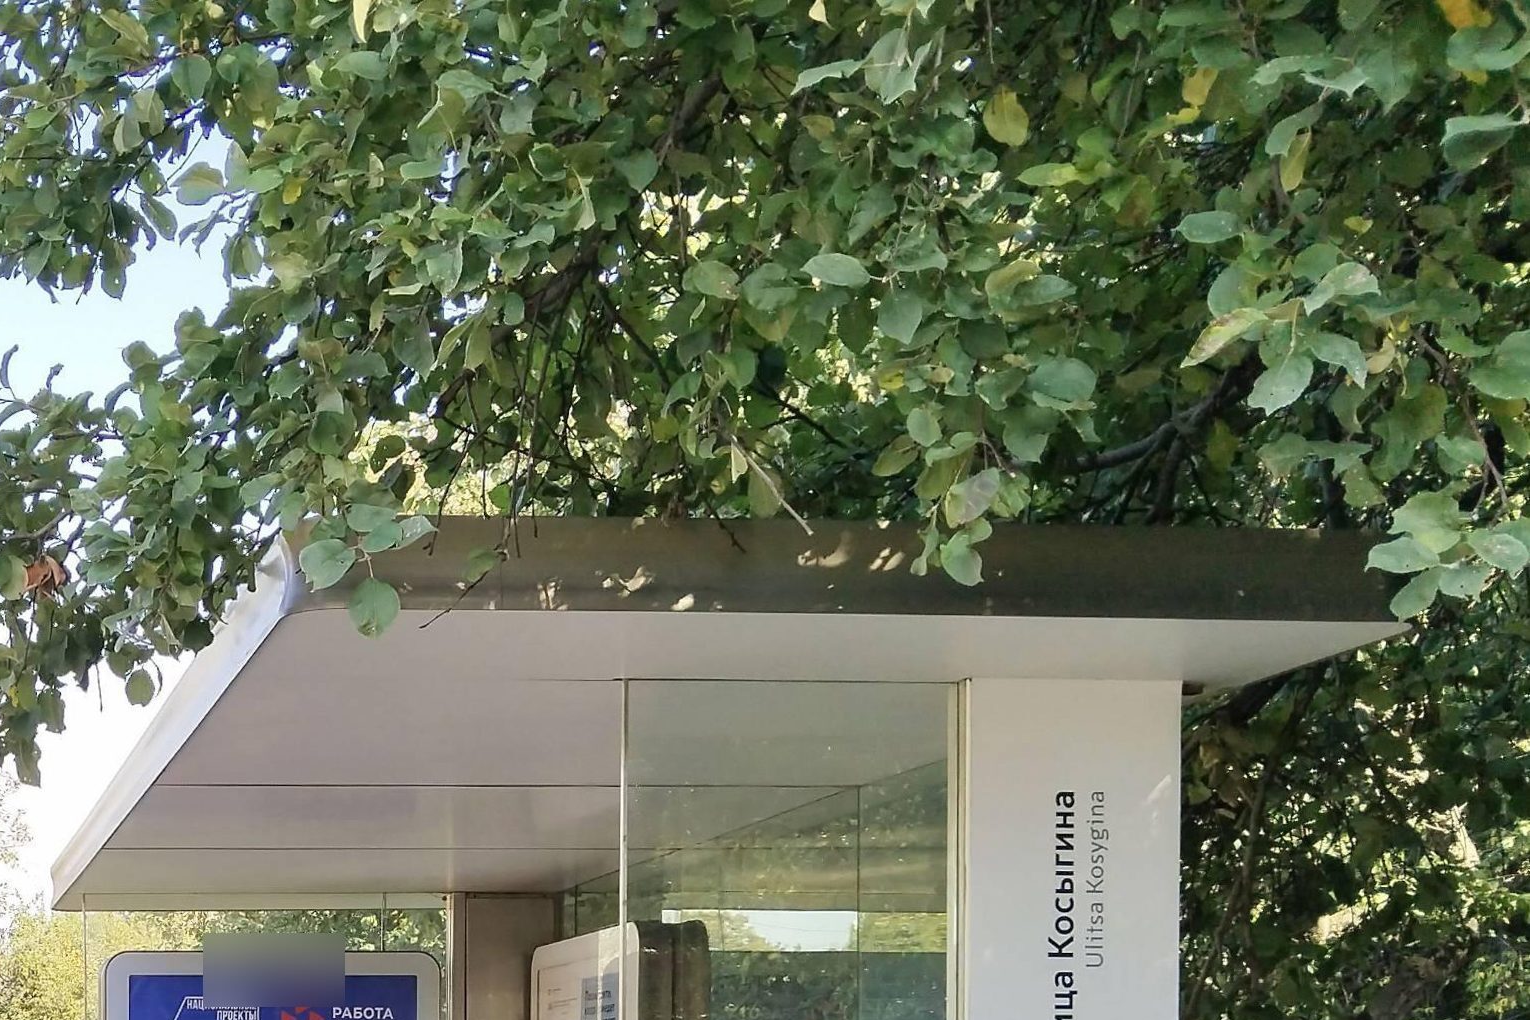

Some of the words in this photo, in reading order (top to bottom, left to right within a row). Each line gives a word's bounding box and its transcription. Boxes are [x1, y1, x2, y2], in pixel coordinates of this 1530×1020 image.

[1047, 790, 1076, 958] Косыгина
[1085, 790, 1110, 894] Kosygina
[1085, 902, 1105, 968] Ulitsa
[216, 1009, 257, 1020] ПРОЕКТЫ
[332, 1007, 394, 1020] РАБОТА
